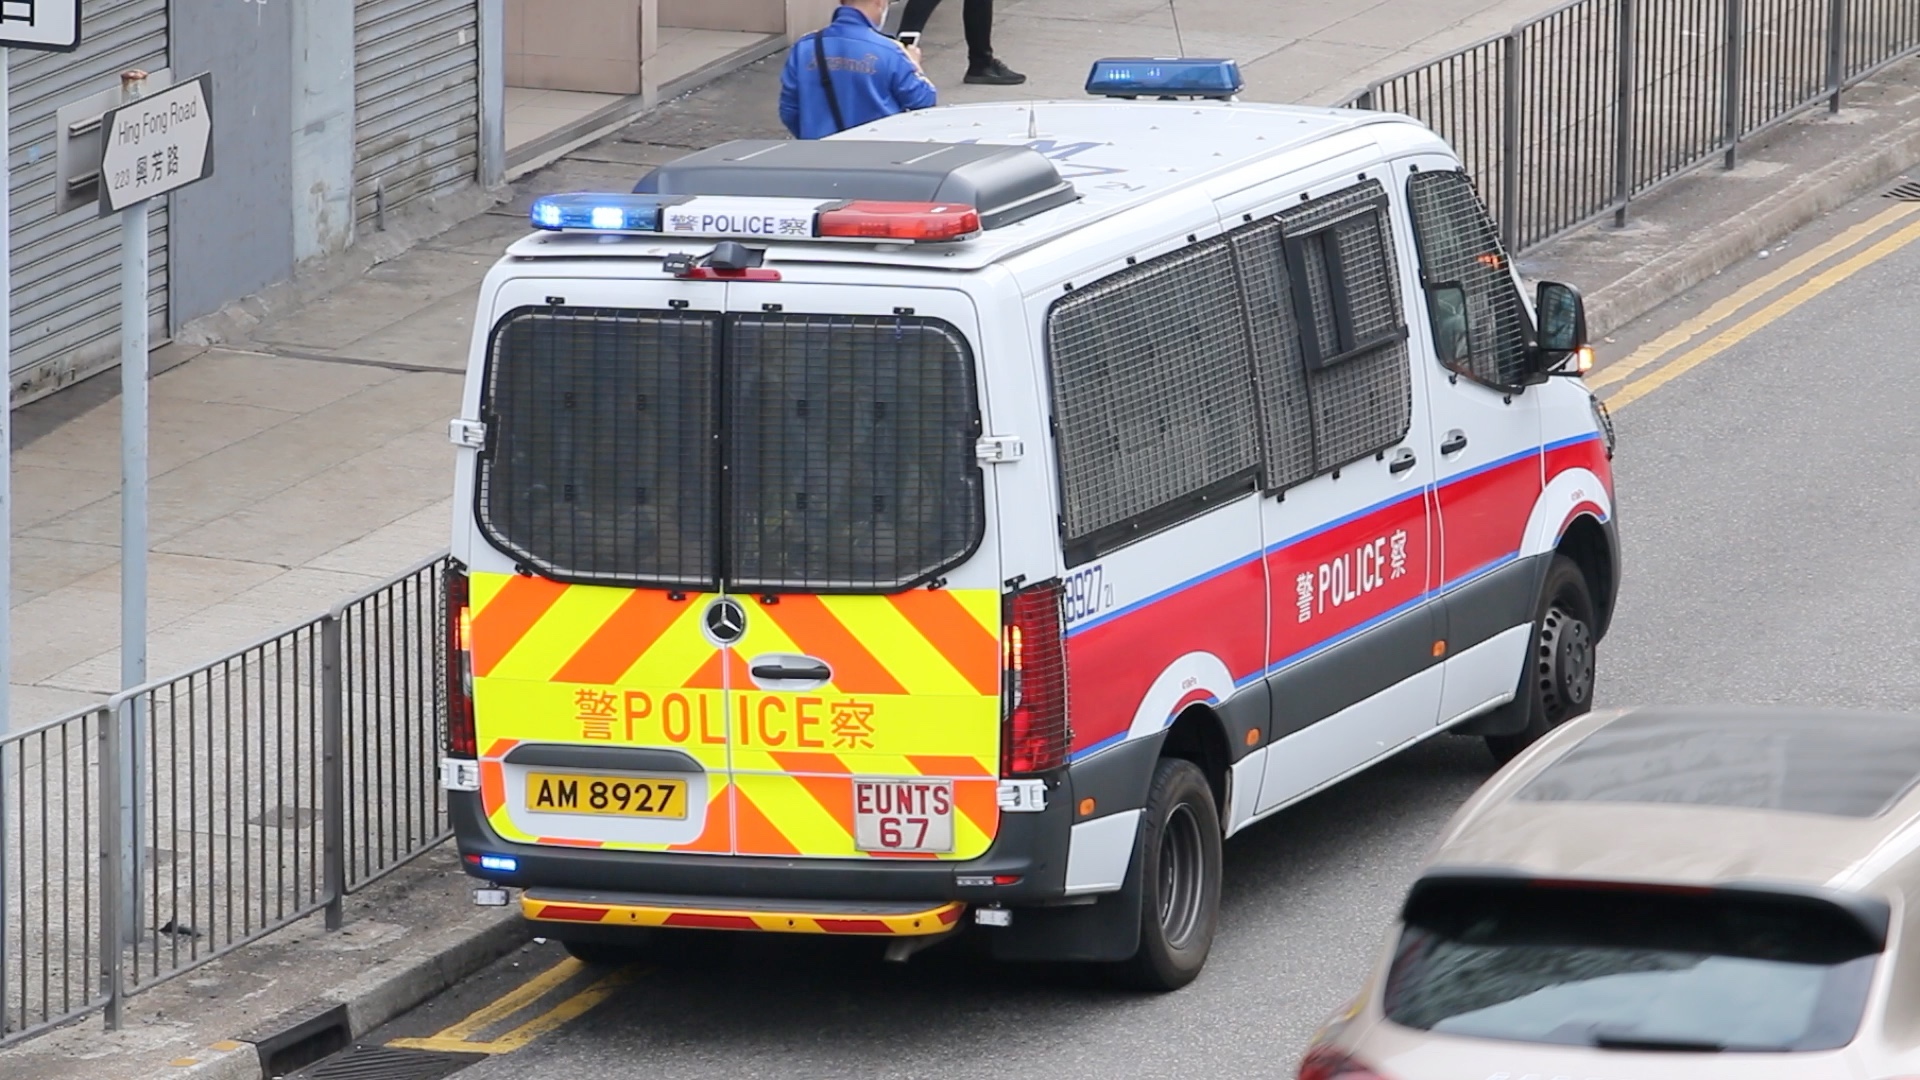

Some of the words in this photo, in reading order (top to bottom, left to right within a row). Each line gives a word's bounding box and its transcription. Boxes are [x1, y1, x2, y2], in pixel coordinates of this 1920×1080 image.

[118, 121, 140, 146] Hing
[143, 112, 167, 137] Fong
[170, 95, 197, 127] Road
[114, 168, 130, 190] 223
[702, 214, 775, 234] POLICE
[1318, 536, 1386, 614] POLICE
[1065, 564, 1102, 623] 8927
[574, 688, 618, 741] 警
[624, 690, 825, 748] POLICE
[830, 698, 875, 749] 察
[536, 779, 578, 809] AM
[589, 781, 677, 813] 8927
[857, 783, 950, 816] EUNTS
[879, 817, 930, 849] 67
